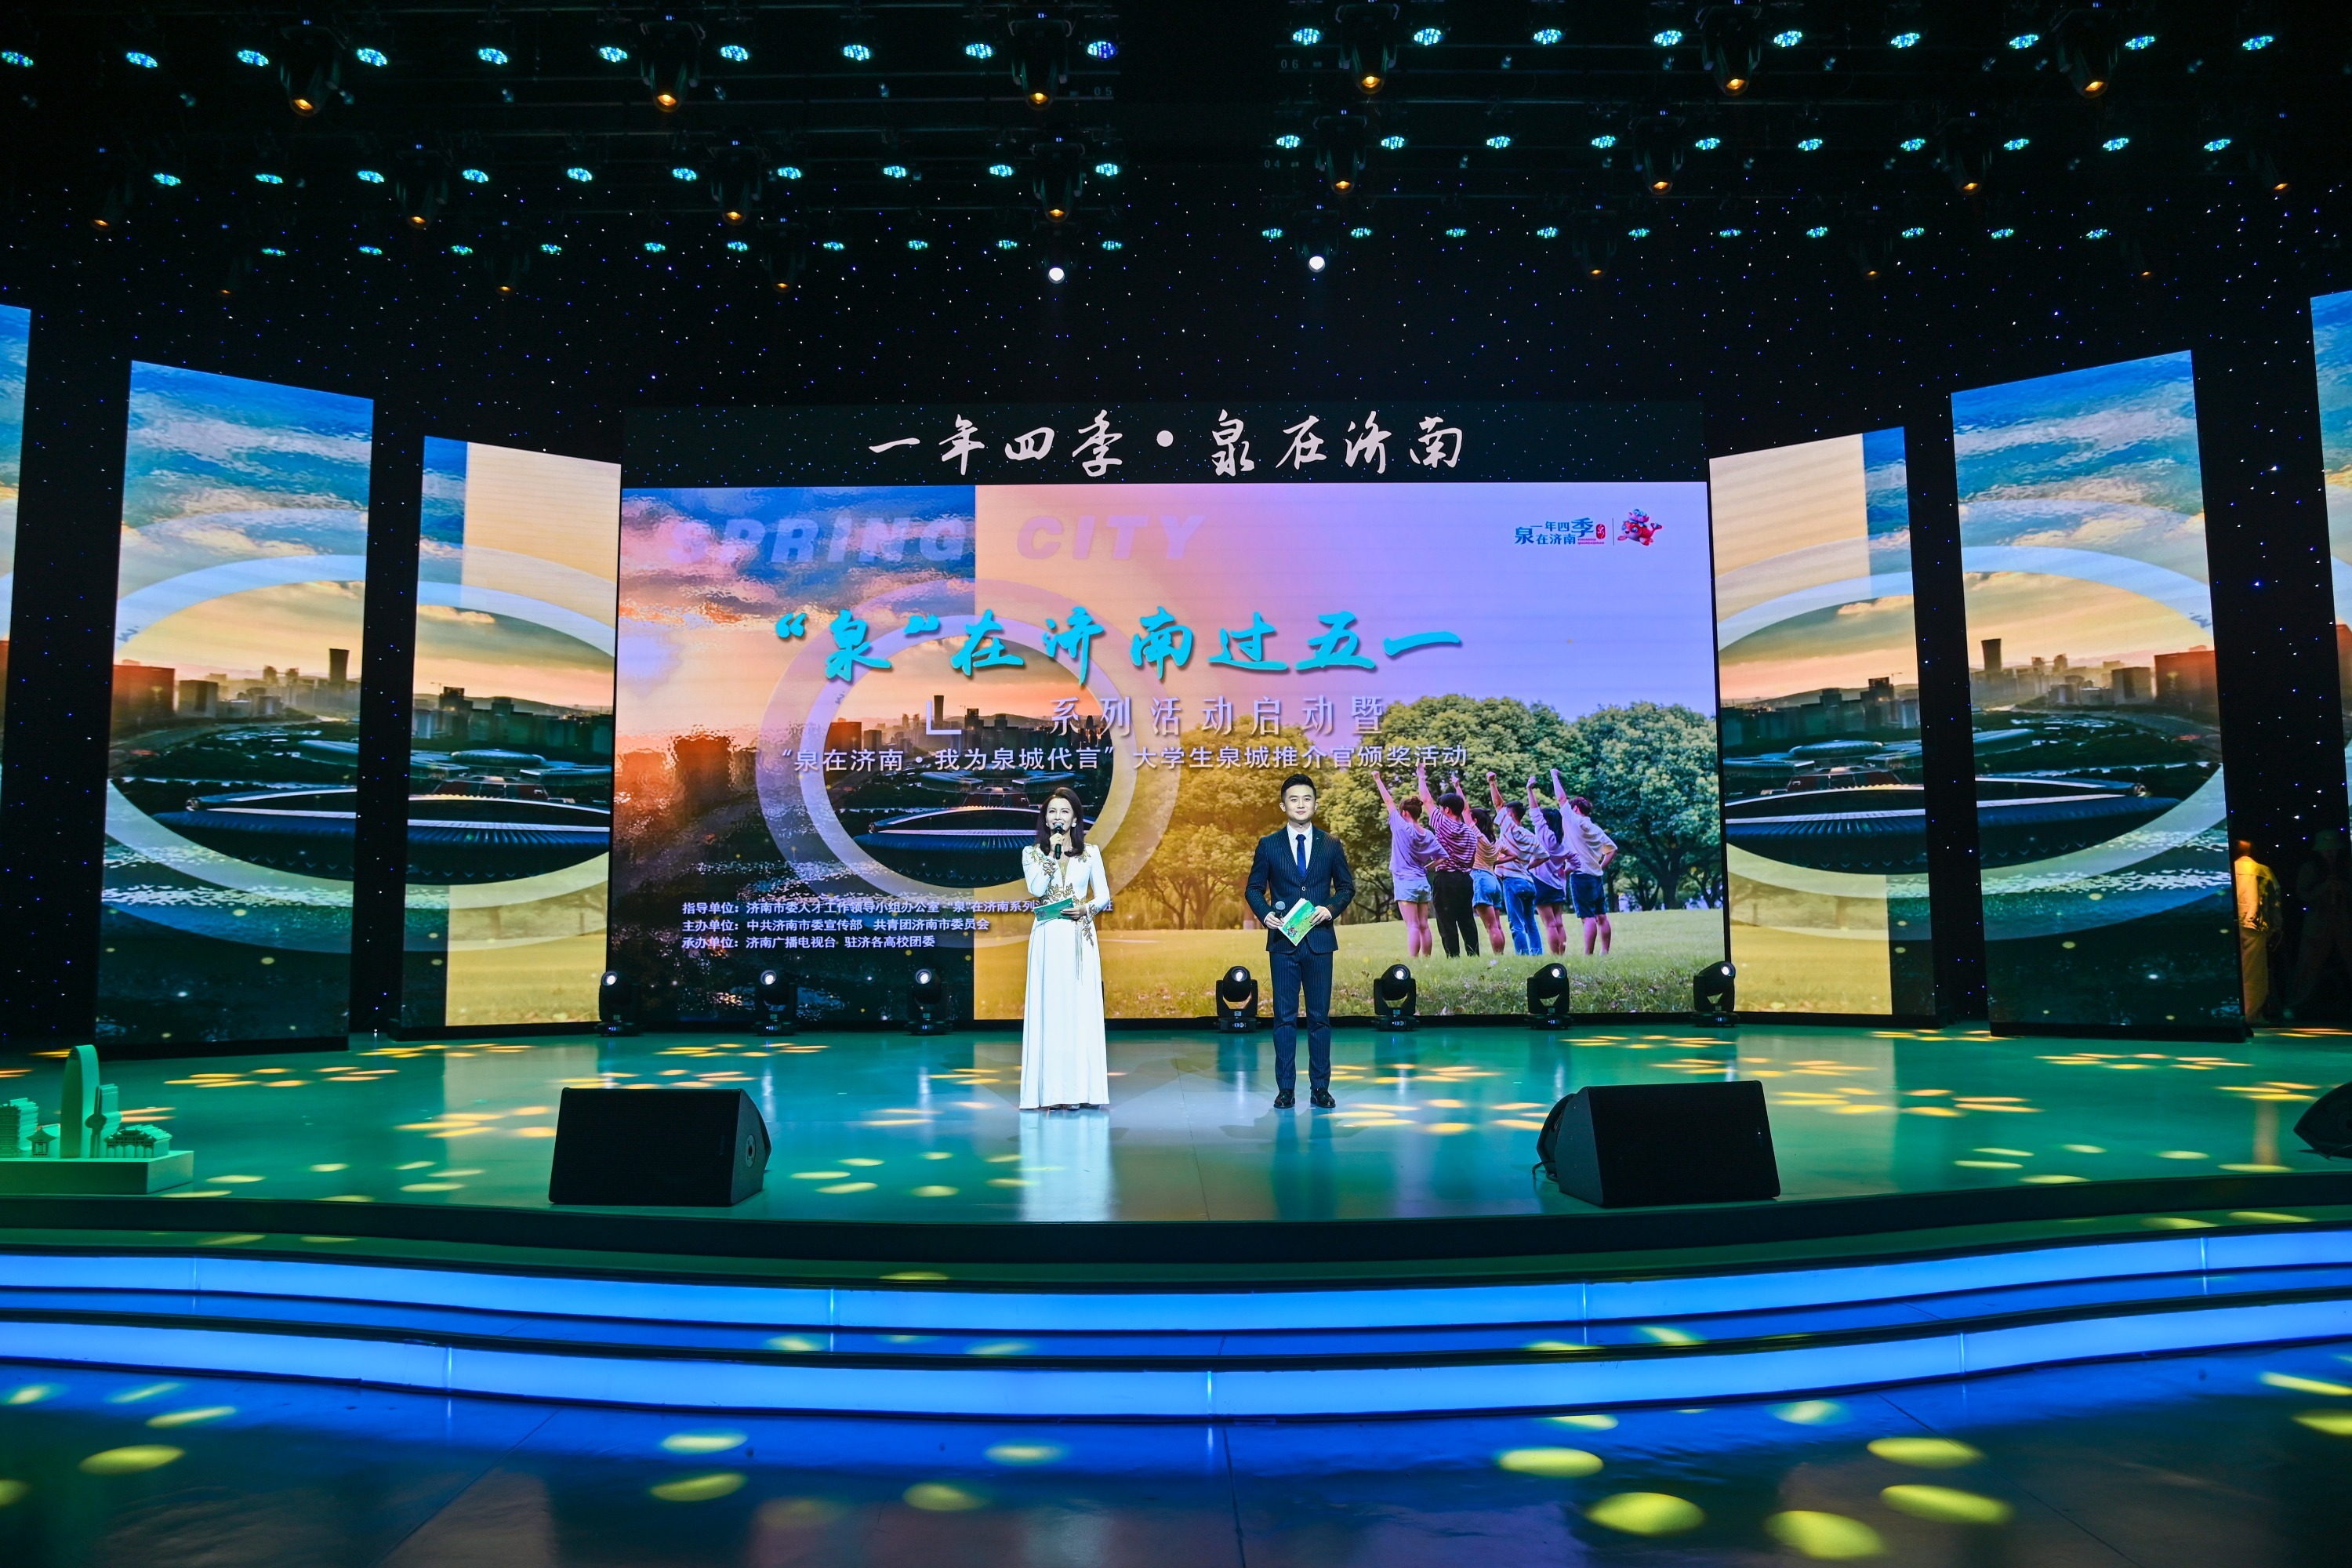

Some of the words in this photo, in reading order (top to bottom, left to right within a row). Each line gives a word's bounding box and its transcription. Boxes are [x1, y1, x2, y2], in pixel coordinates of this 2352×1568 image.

[1280, 59, 1299, 69] 06
[1094, 86, 1112, 96] 05
[666, 517, 967, 564] SPRING
[1018, 515, 1205, 561] CITY
[1514, 526, 1577, 545] 泉在济南
[1050, 695, 1383, 736] 系列活动启动暨
[1132, 744, 1468, 771] 大学生泉城推介官颁奖活动
[873, 918, 990, 931] 共青团济南市委员会
[844, 935, 936, 949] 驻济各高校团委
